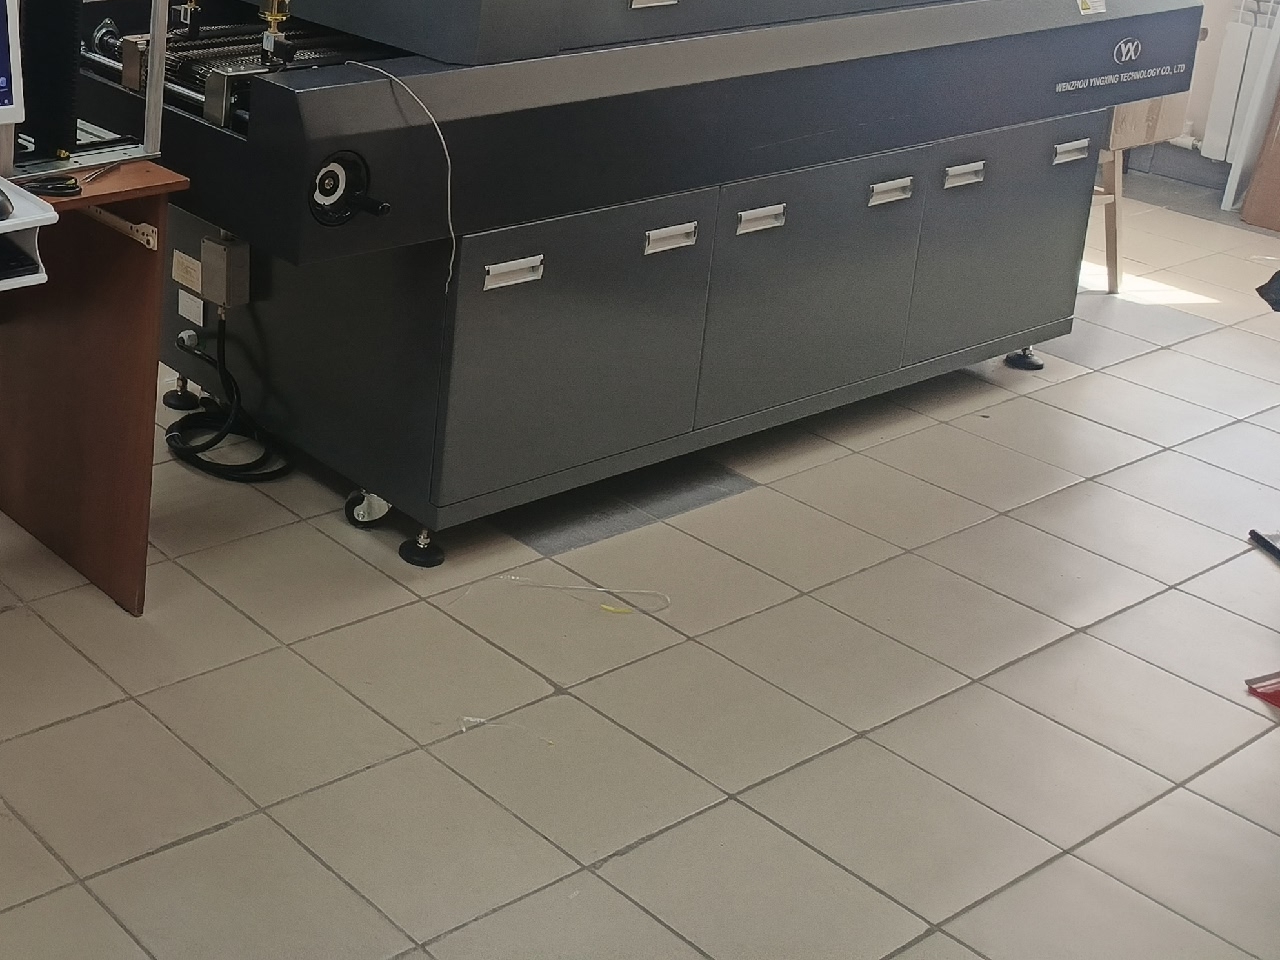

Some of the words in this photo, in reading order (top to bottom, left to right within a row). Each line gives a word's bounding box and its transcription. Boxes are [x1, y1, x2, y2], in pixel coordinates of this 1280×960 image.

[1120, 41, 1138, 62] YX
[1055, 78, 1089, 93] WENZHOU
[1120, 68, 1161, 82] TECHNOLOGY
